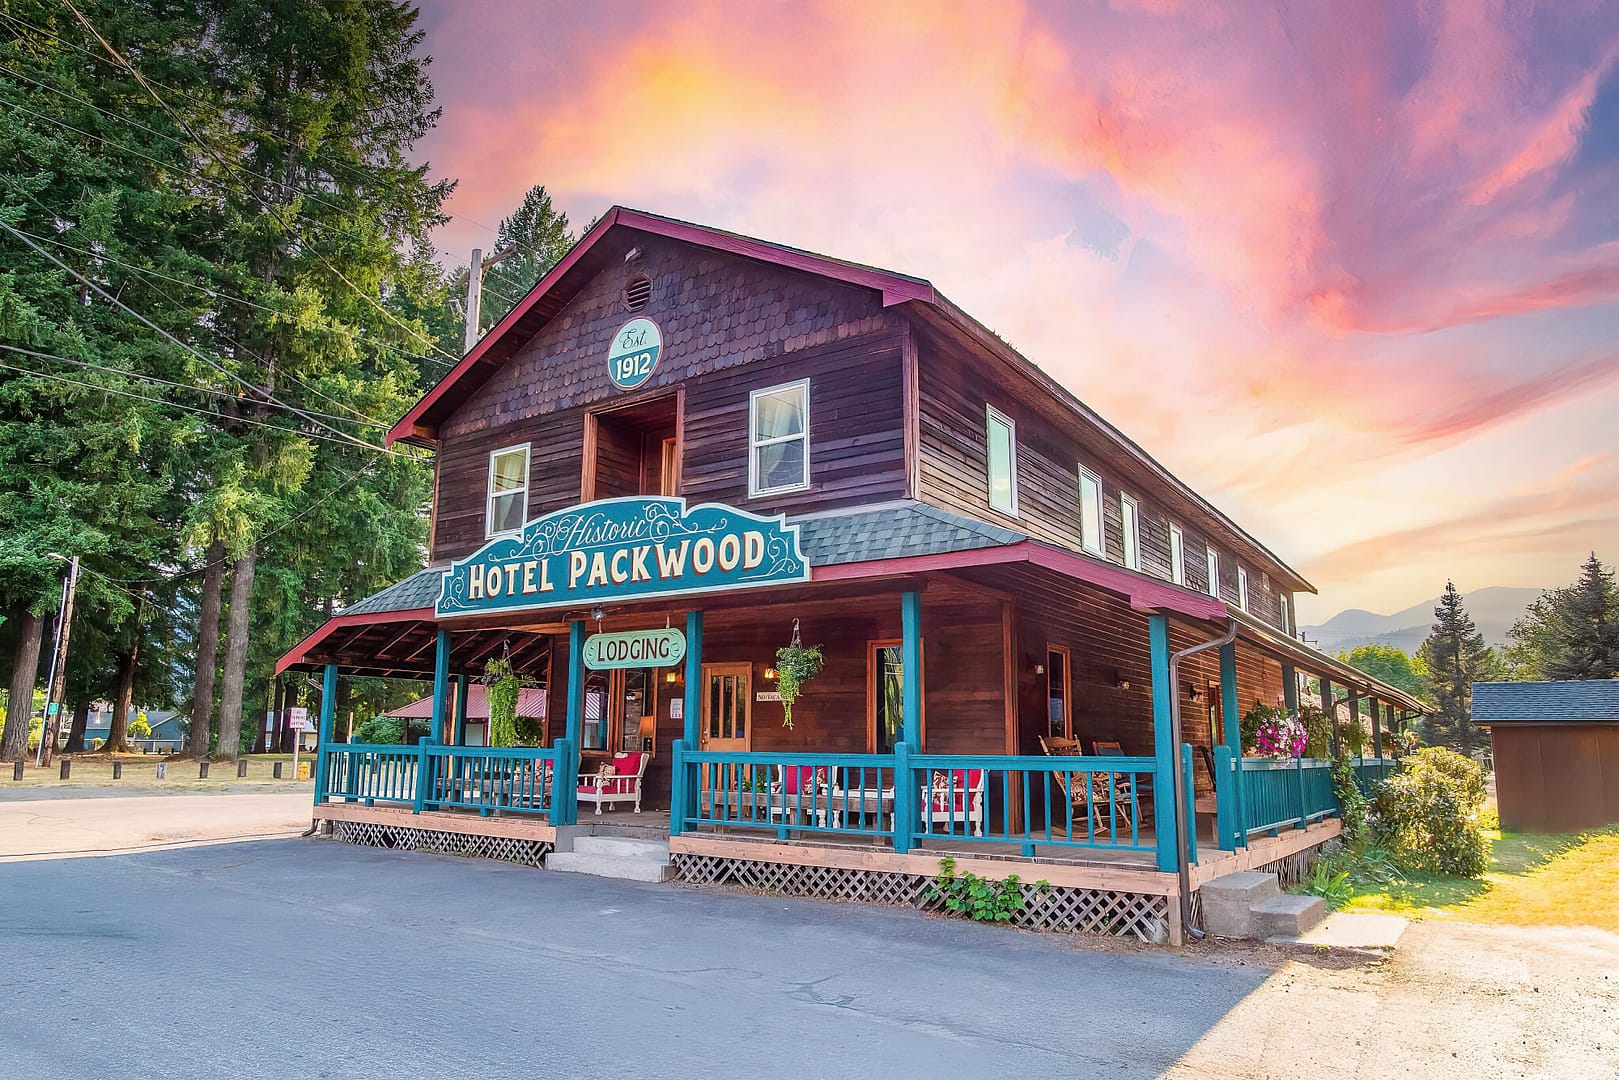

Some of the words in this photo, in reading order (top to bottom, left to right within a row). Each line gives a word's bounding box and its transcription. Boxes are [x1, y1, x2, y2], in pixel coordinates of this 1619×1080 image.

[616, 352, 651, 381] 1912
[553, 512, 649, 555] Historic
[468, 558, 554, 600] HOTEL
[568, 530, 766, 590] PACKWOOD
[597, 637, 670, 662] LODGING
